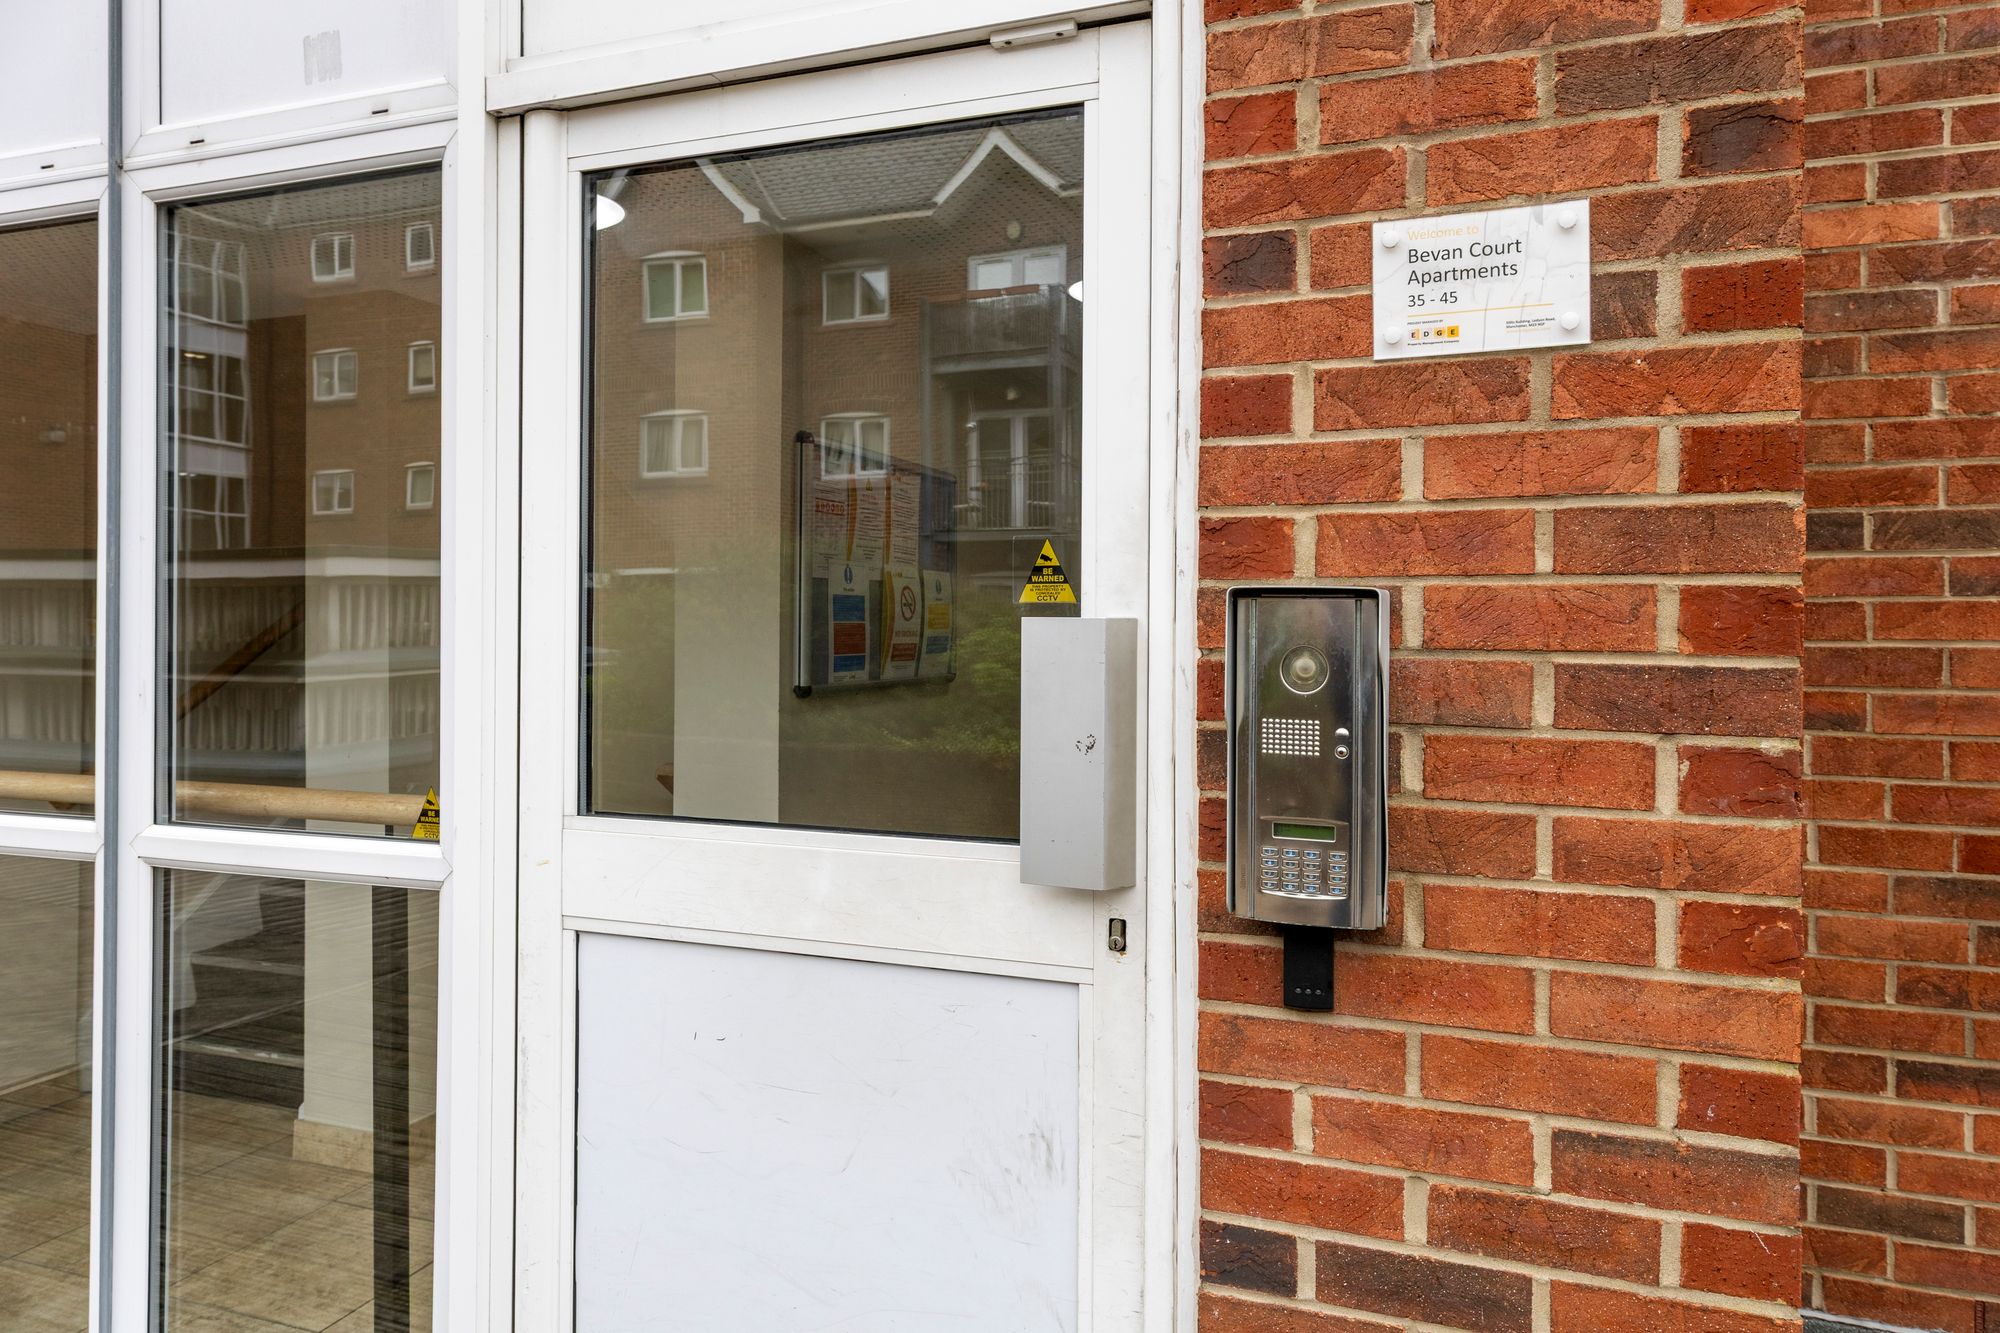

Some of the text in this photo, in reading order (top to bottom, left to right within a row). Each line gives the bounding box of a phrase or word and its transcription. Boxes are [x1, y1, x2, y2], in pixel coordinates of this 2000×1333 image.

[1407, 225, 1480, 241] Welcome to
[1407, 239, 1522, 264] Bevan Court
[1407, 262, 1518, 287] Apartments
[1407, 293, 1425, 308] 35
[1440, 291, 1458, 304] 45
[1042, 567, 1053, 575] BE
